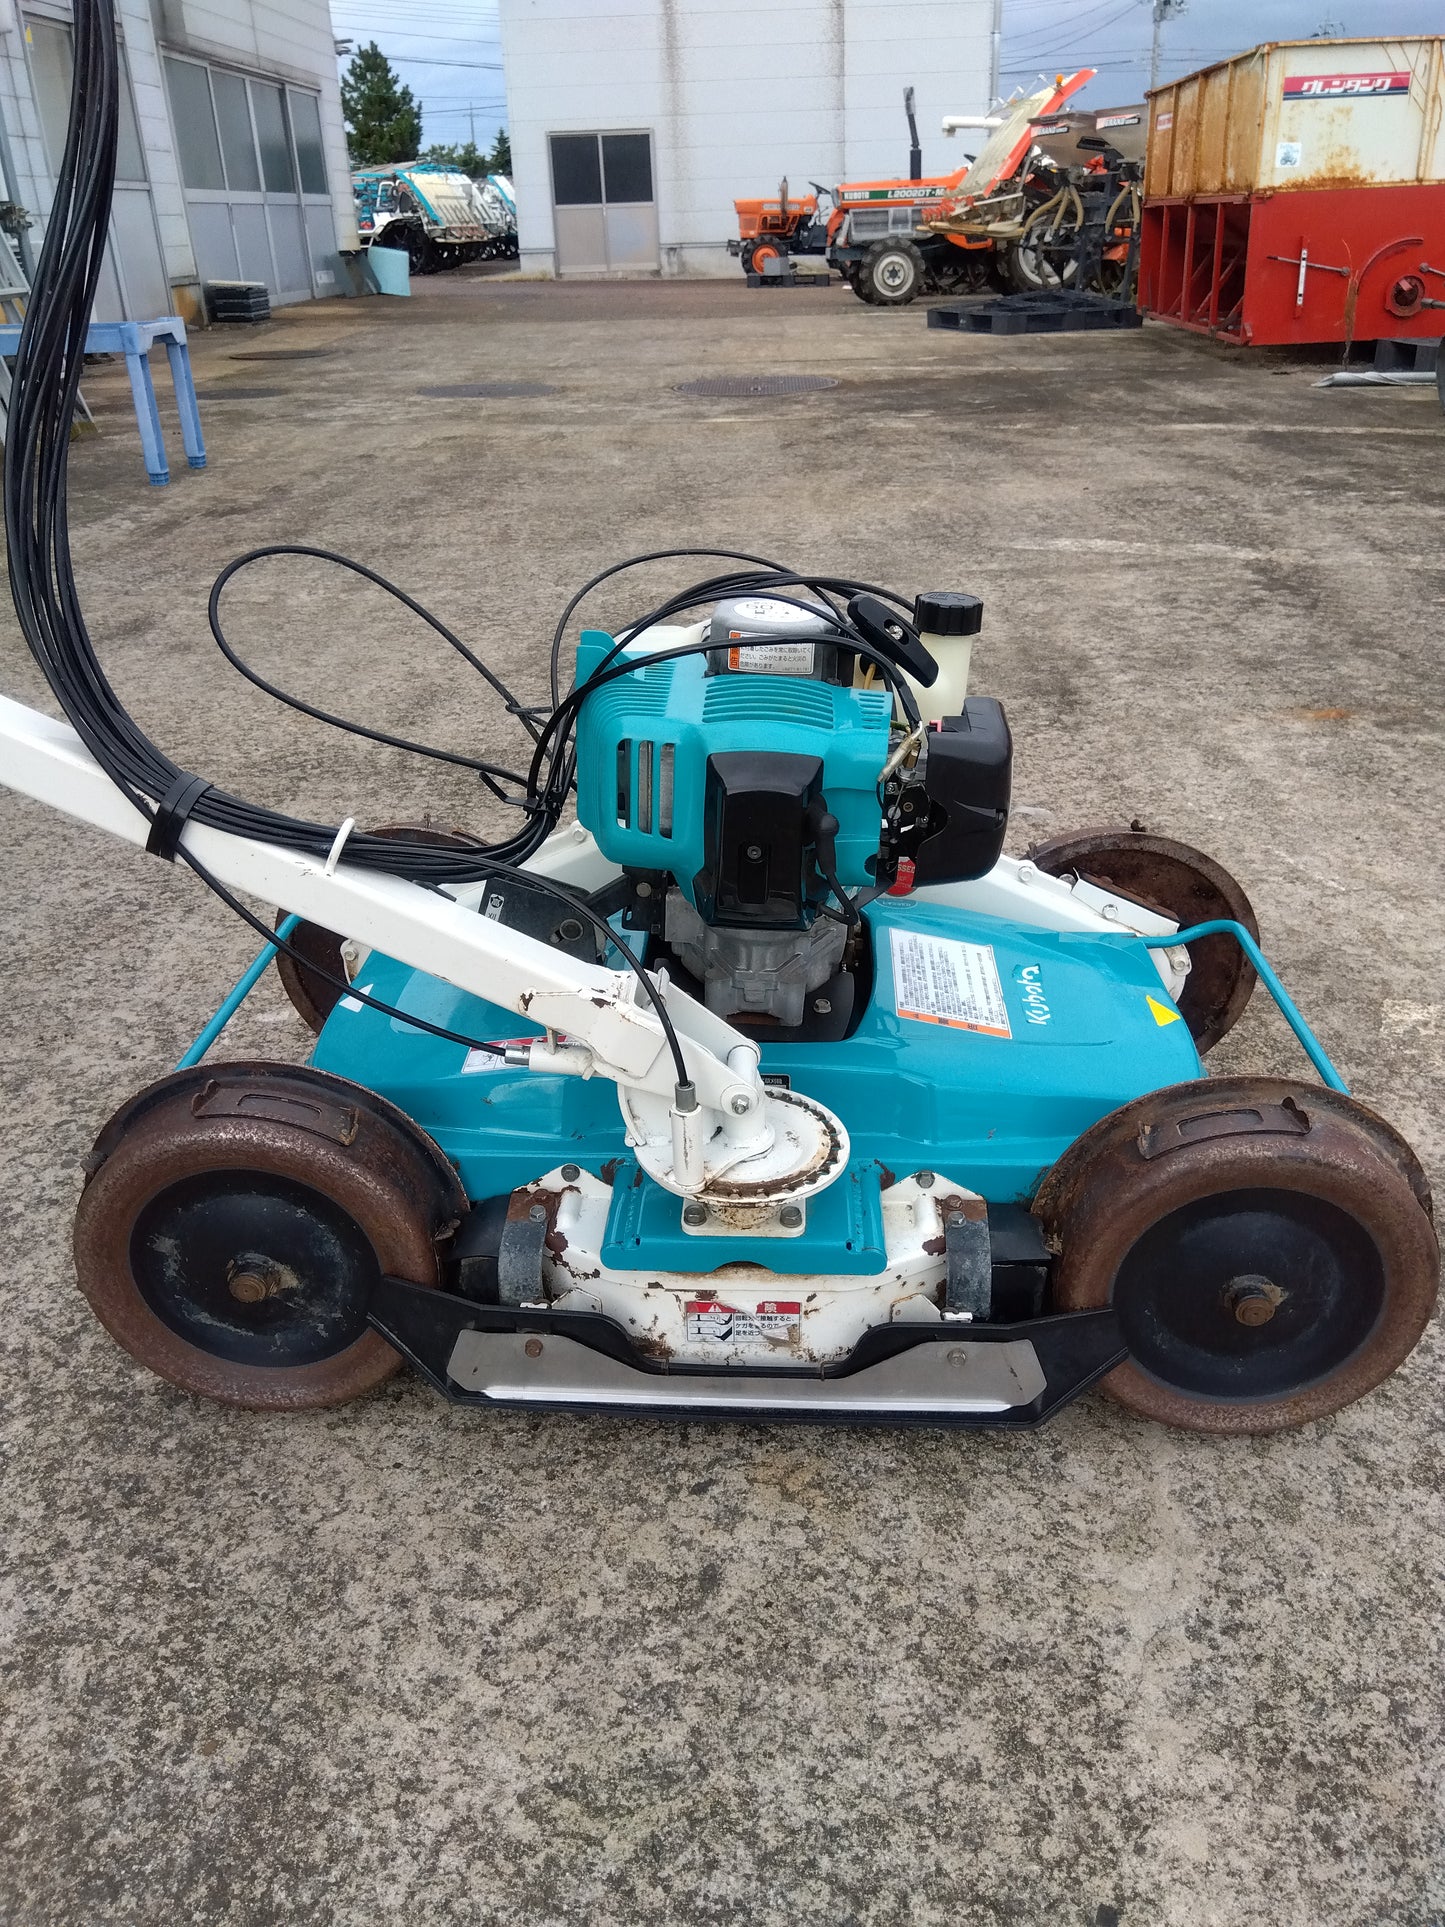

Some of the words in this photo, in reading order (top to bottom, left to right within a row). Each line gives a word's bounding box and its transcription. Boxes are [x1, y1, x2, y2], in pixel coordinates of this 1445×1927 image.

[1301, 78, 1392, 95] グレンタンク
[1017, 965, 1051, 1025] Kubota
